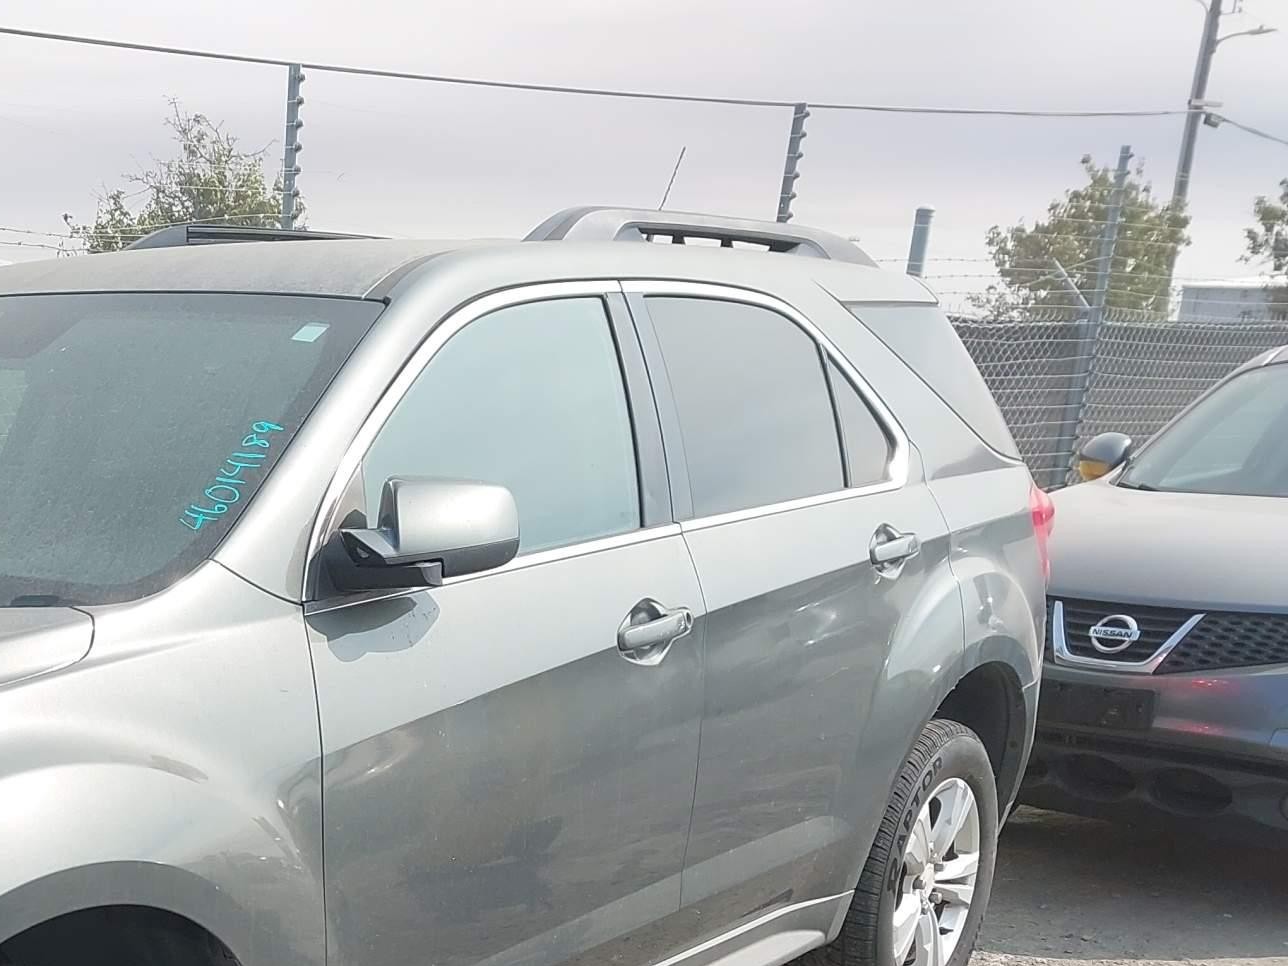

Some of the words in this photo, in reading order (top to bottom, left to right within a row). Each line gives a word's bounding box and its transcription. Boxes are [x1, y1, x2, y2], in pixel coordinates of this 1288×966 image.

[179, 421, 284, 530] 46014189
[1092, 628, 1133, 639] NISSAN
[886, 756, 943, 895] RAPTOR
